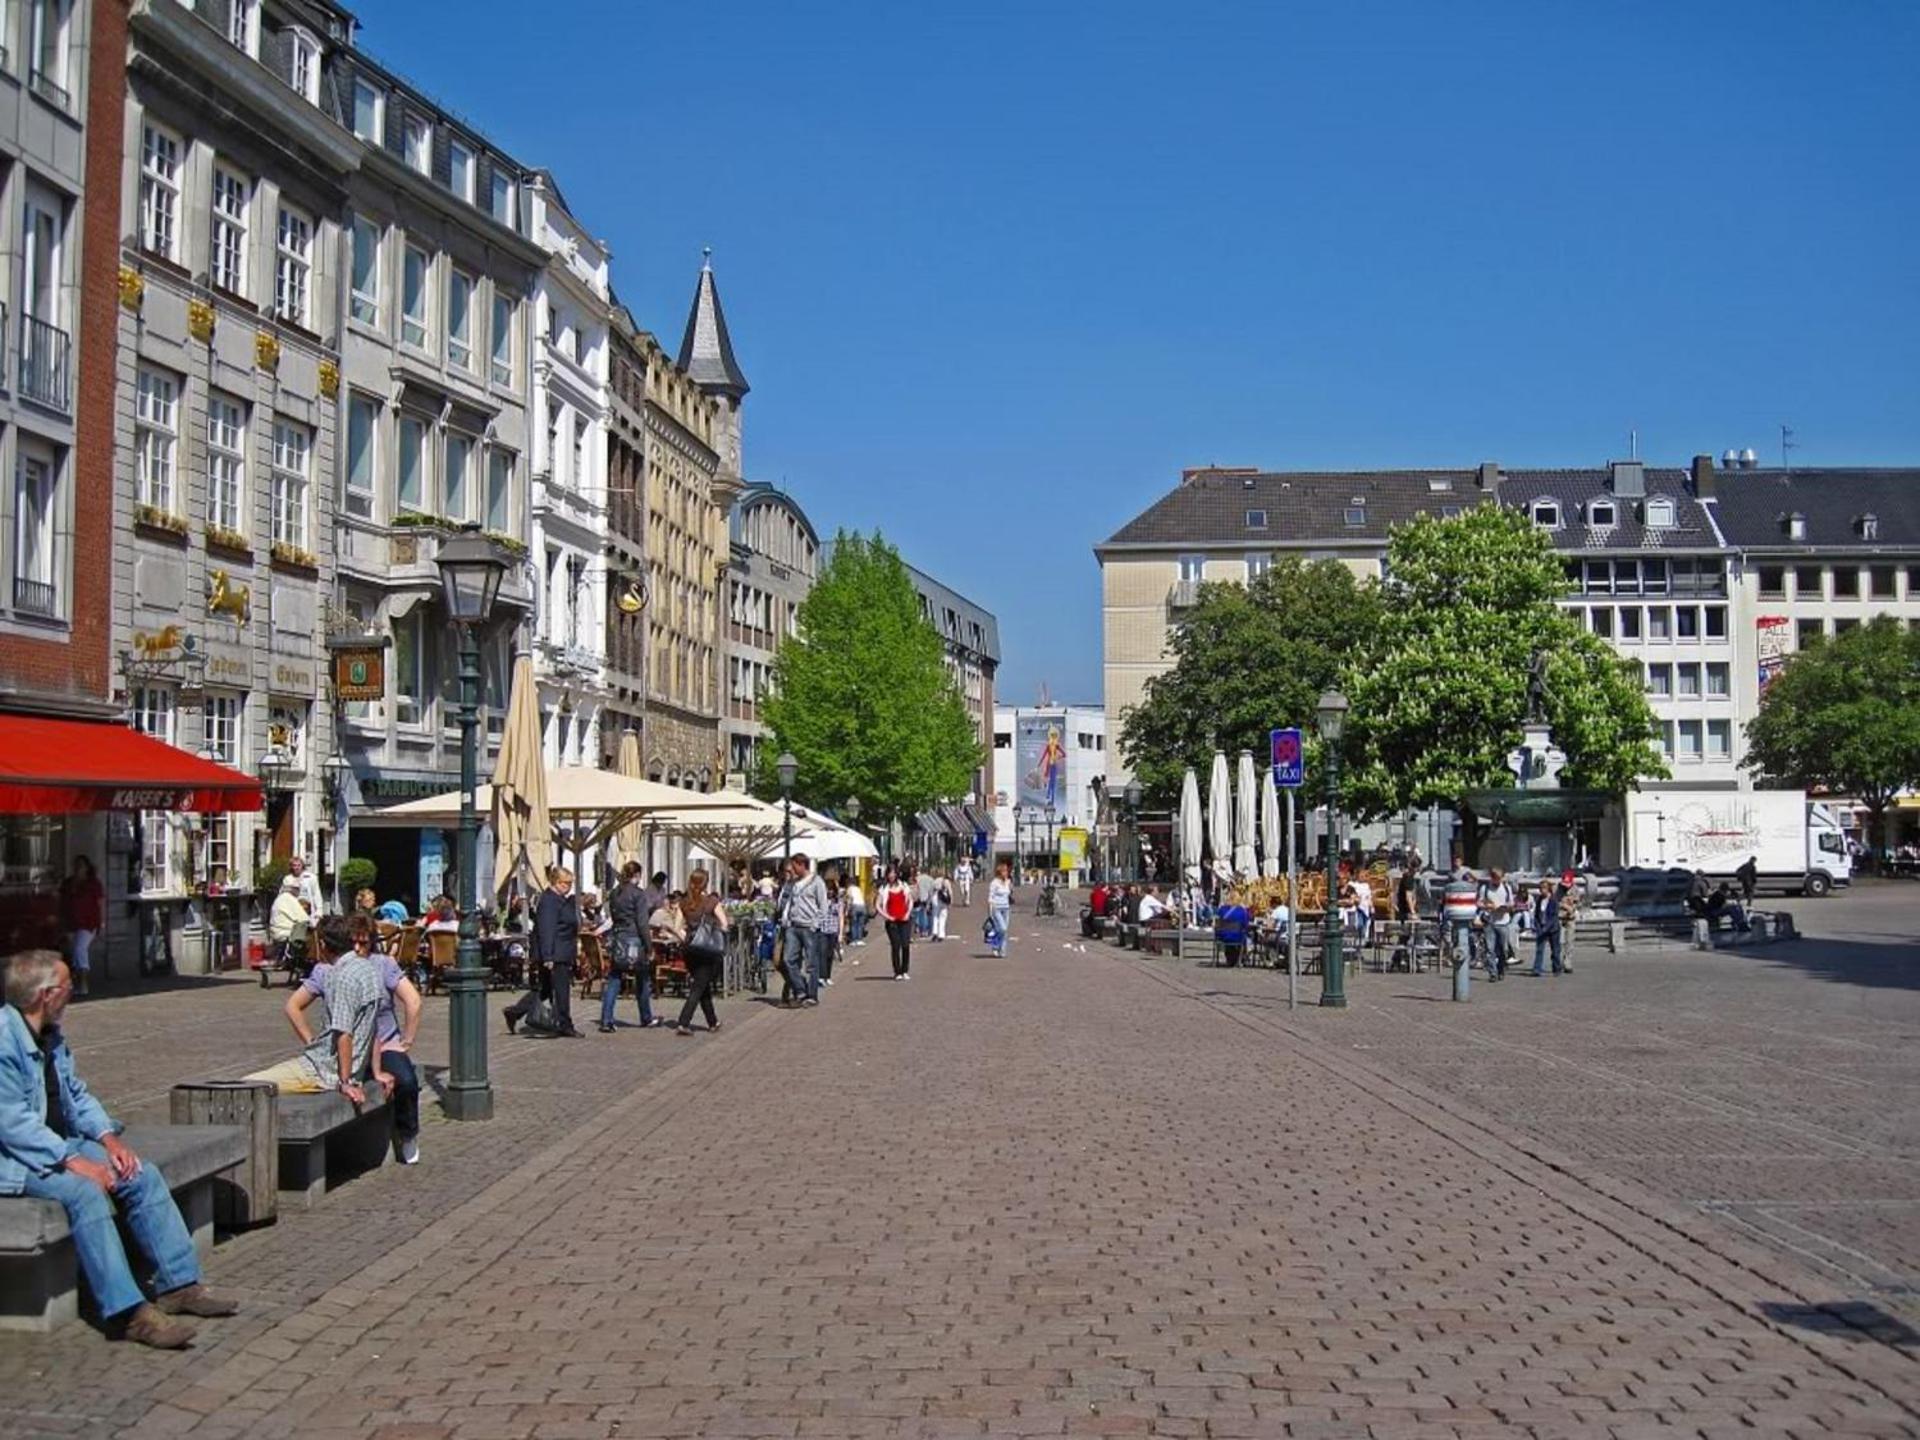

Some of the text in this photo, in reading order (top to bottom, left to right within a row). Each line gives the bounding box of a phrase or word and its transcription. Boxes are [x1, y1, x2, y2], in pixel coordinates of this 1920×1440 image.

[1764, 626, 1788, 636] ALL
[1759, 645, 1780, 655] EA
[1276, 767, 1300, 780] TAXI
[366, 779, 440, 798] STARBUCKS
[111, 790, 176, 808] KAISER'S
